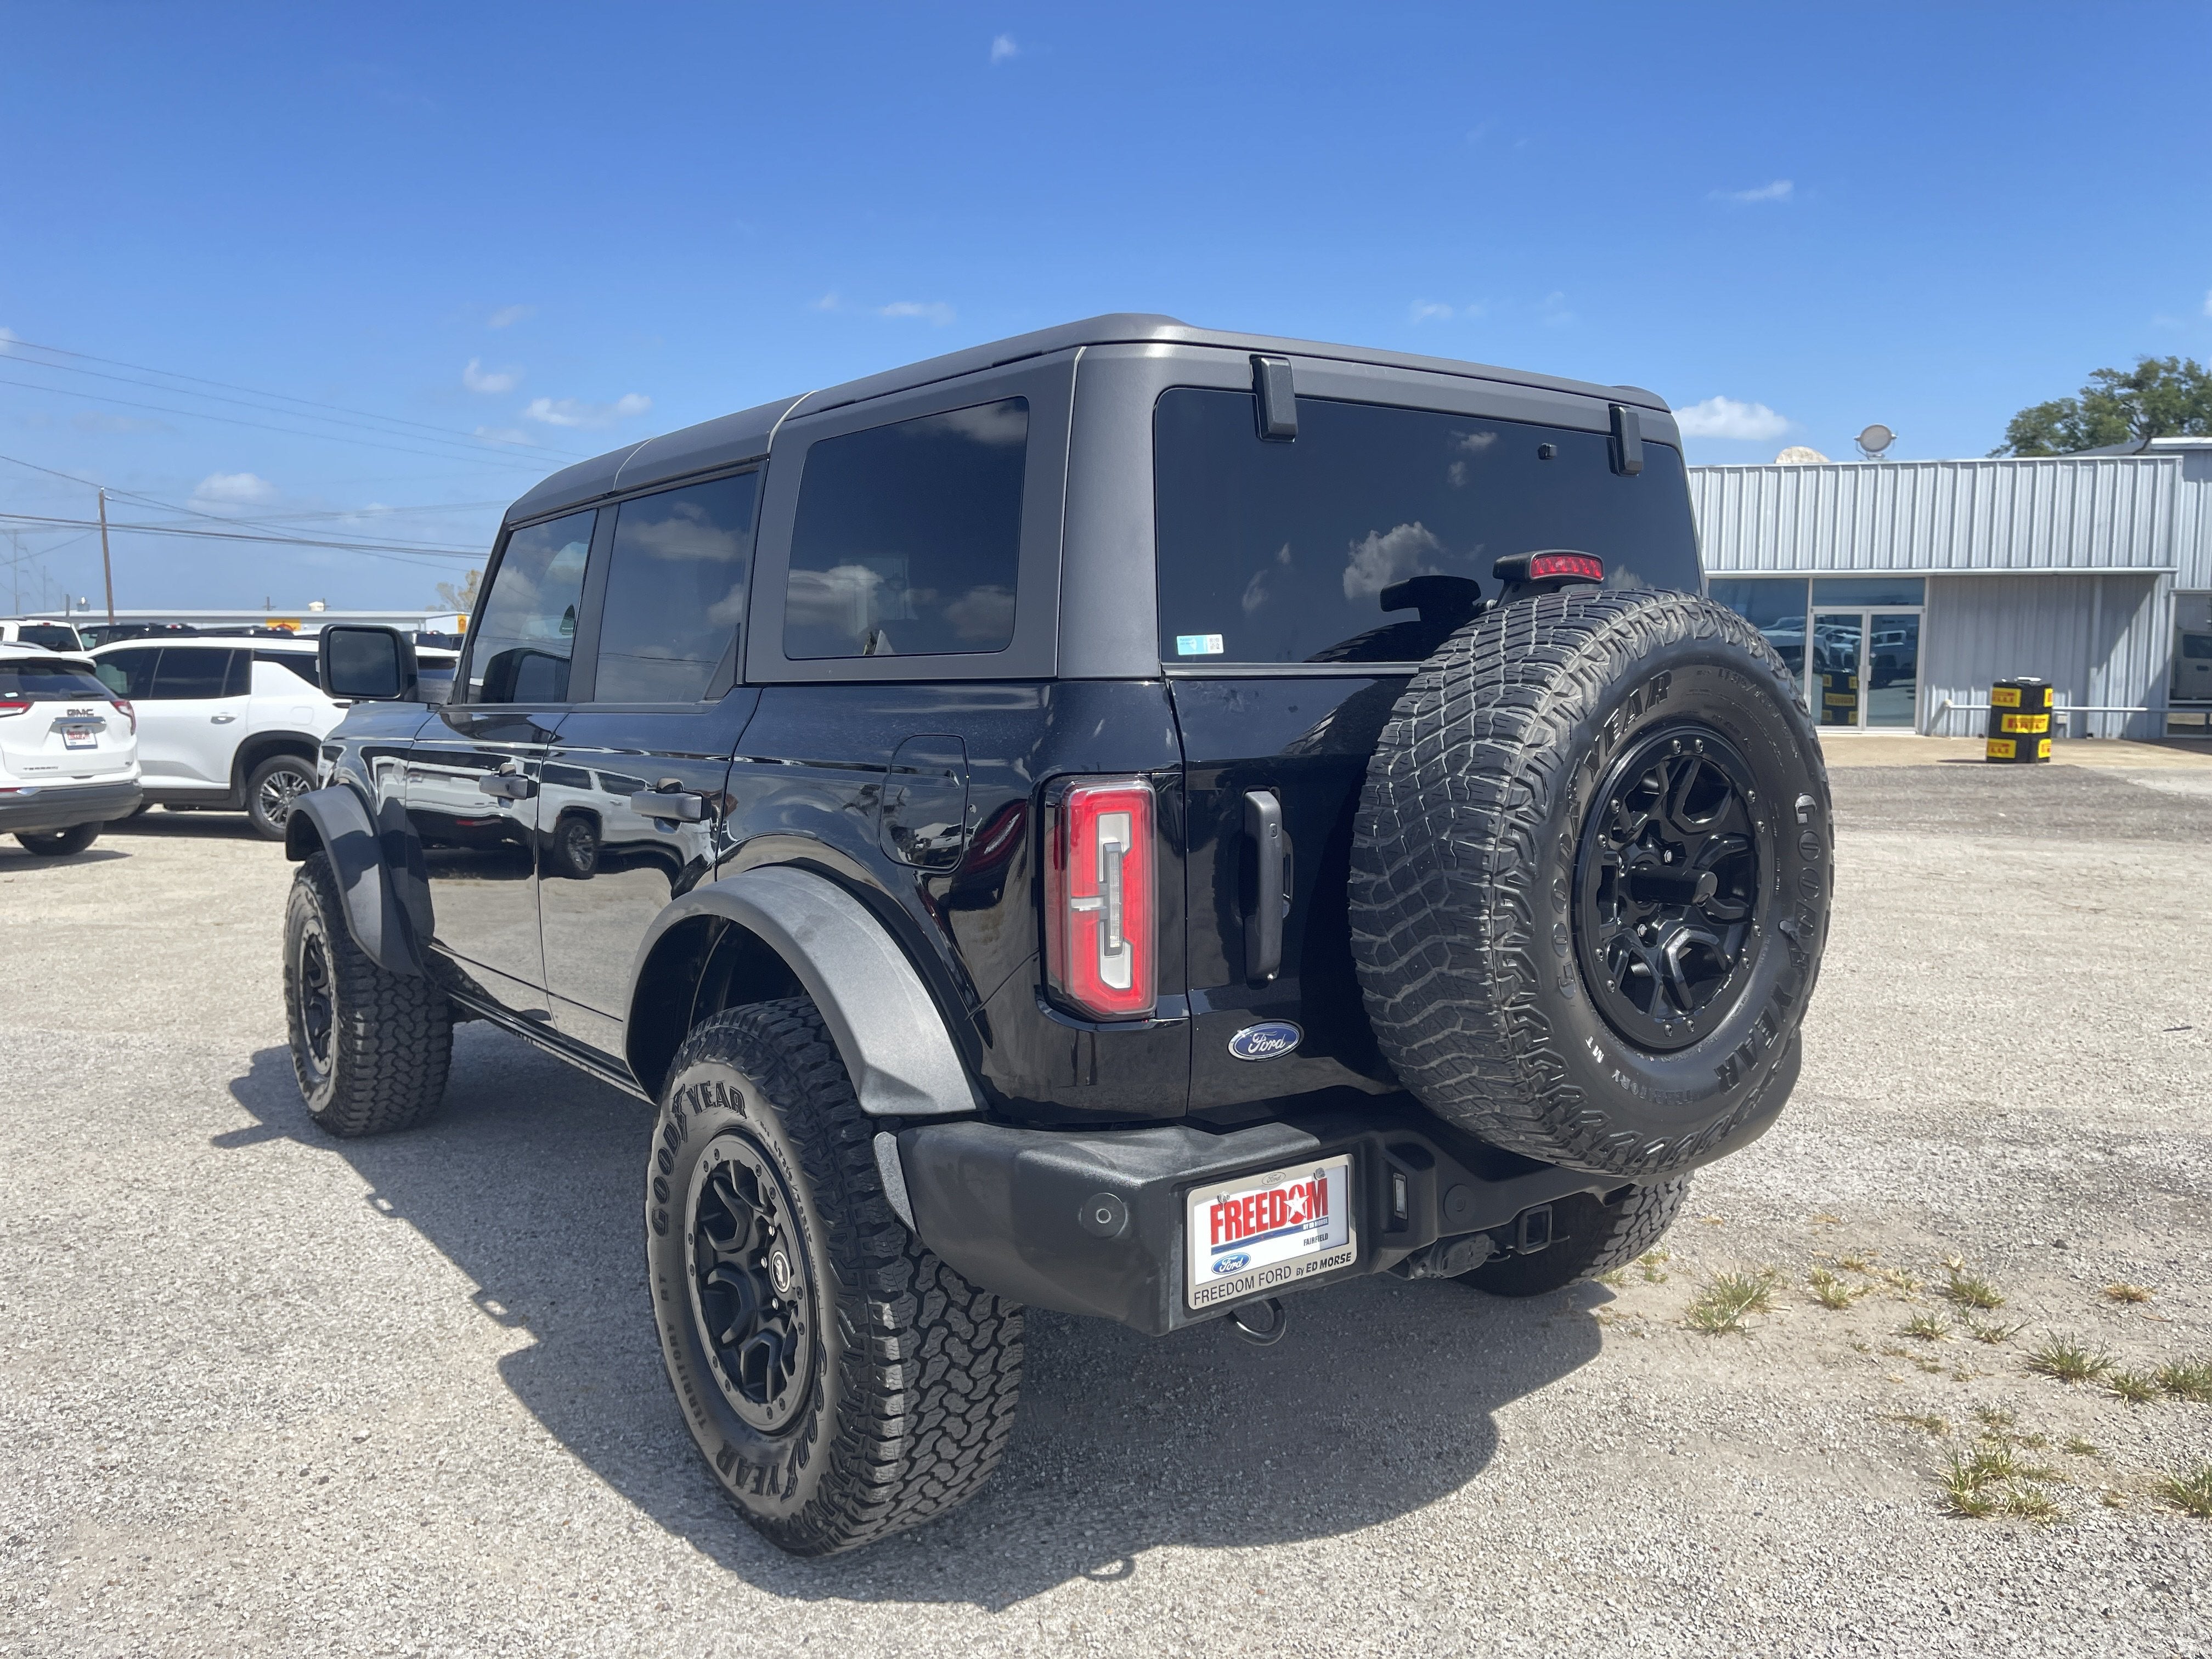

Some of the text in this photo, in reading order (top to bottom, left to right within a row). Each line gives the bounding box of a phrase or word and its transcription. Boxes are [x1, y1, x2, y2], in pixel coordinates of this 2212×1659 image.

[1714, 793, 1821, 1095] GOODYEAR
[1248, 1030, 1286, 1053] Ford
[651, 1080, 748, 1237] GOODYEAR
[1210, 1178, 1329, 1245] FREEDOM
[1304, 1233, 1328, 1246] FAIRFIELD
[1194, 1276, 1254, 1306] FREEDOM
[1259, 1266, 1291, 1286] FORD
[1306, 1261, 1318, 1273] ED
[1319, 1252, 1352, 1270] MORSE
[1218, 1256, 1243, 1272] Ford
[665, 1323, 707, 1430] TERRITORY
